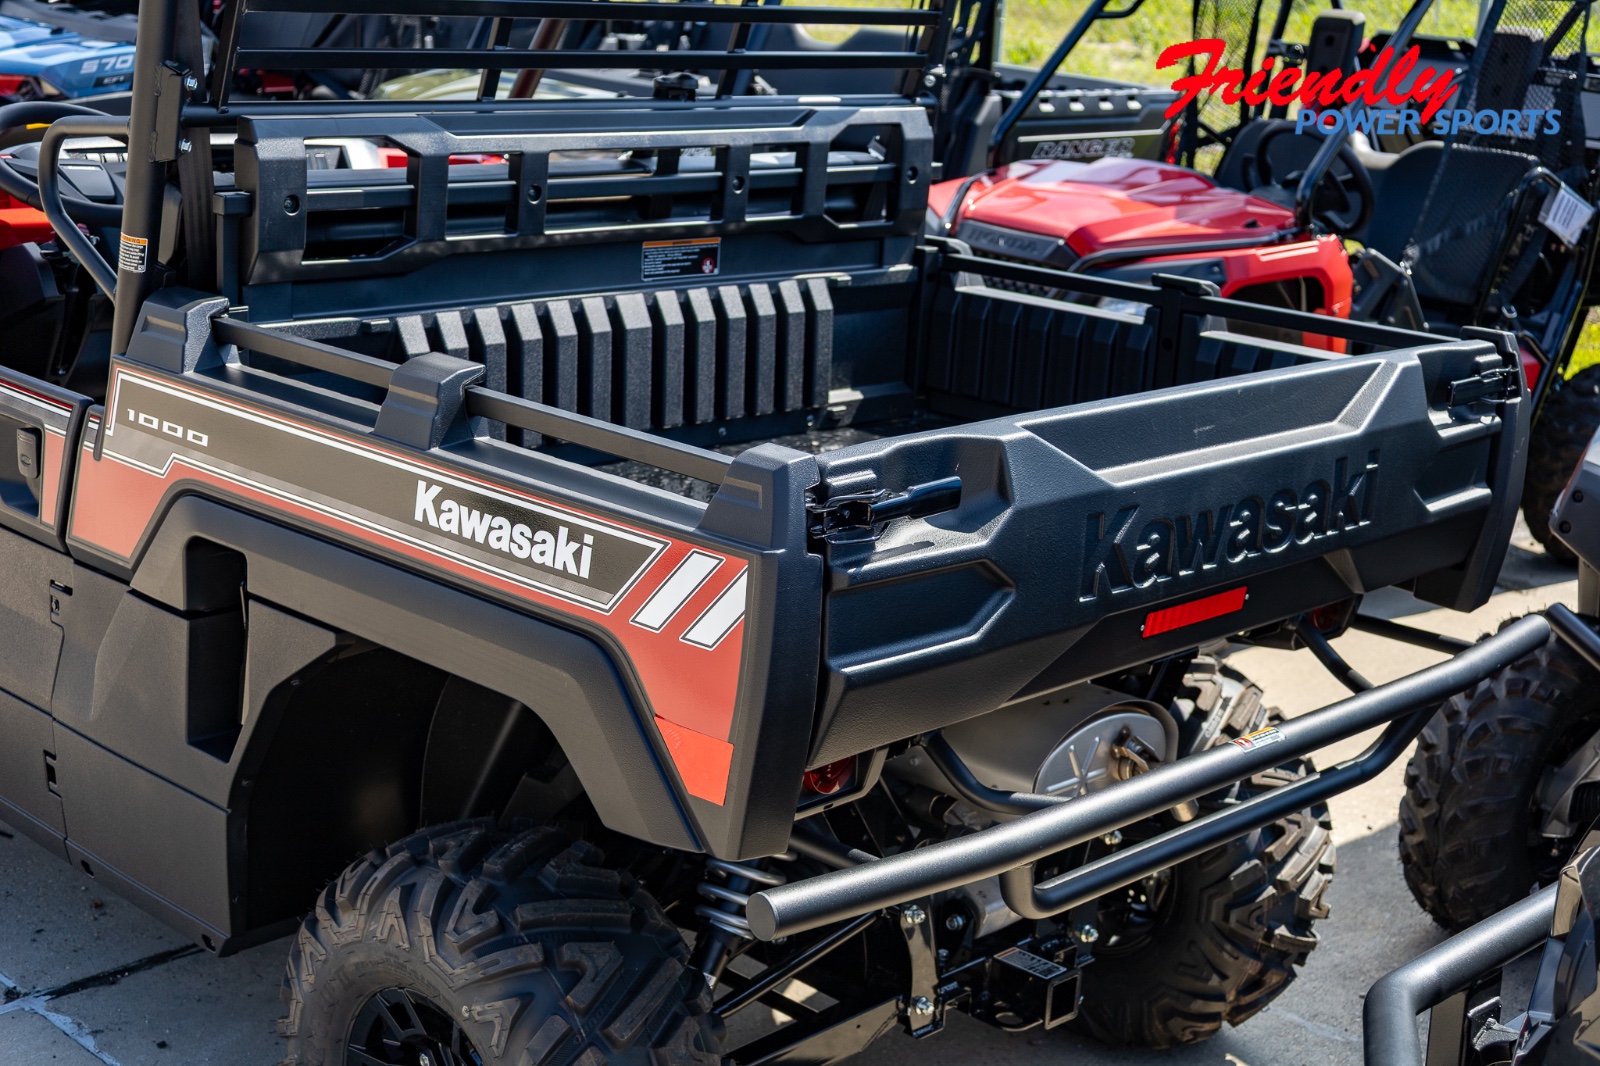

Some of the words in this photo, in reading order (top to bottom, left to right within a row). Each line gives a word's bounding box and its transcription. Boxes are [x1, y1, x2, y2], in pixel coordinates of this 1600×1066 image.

[80, 54, 135, 74] 570
[1031, 137, 1136, 160] RANGER
[127, 408, 209, 448] 1000
[414, 479, 594, 579] Kawasaki
[1079, 448, 1381, 602] Kawasaki
